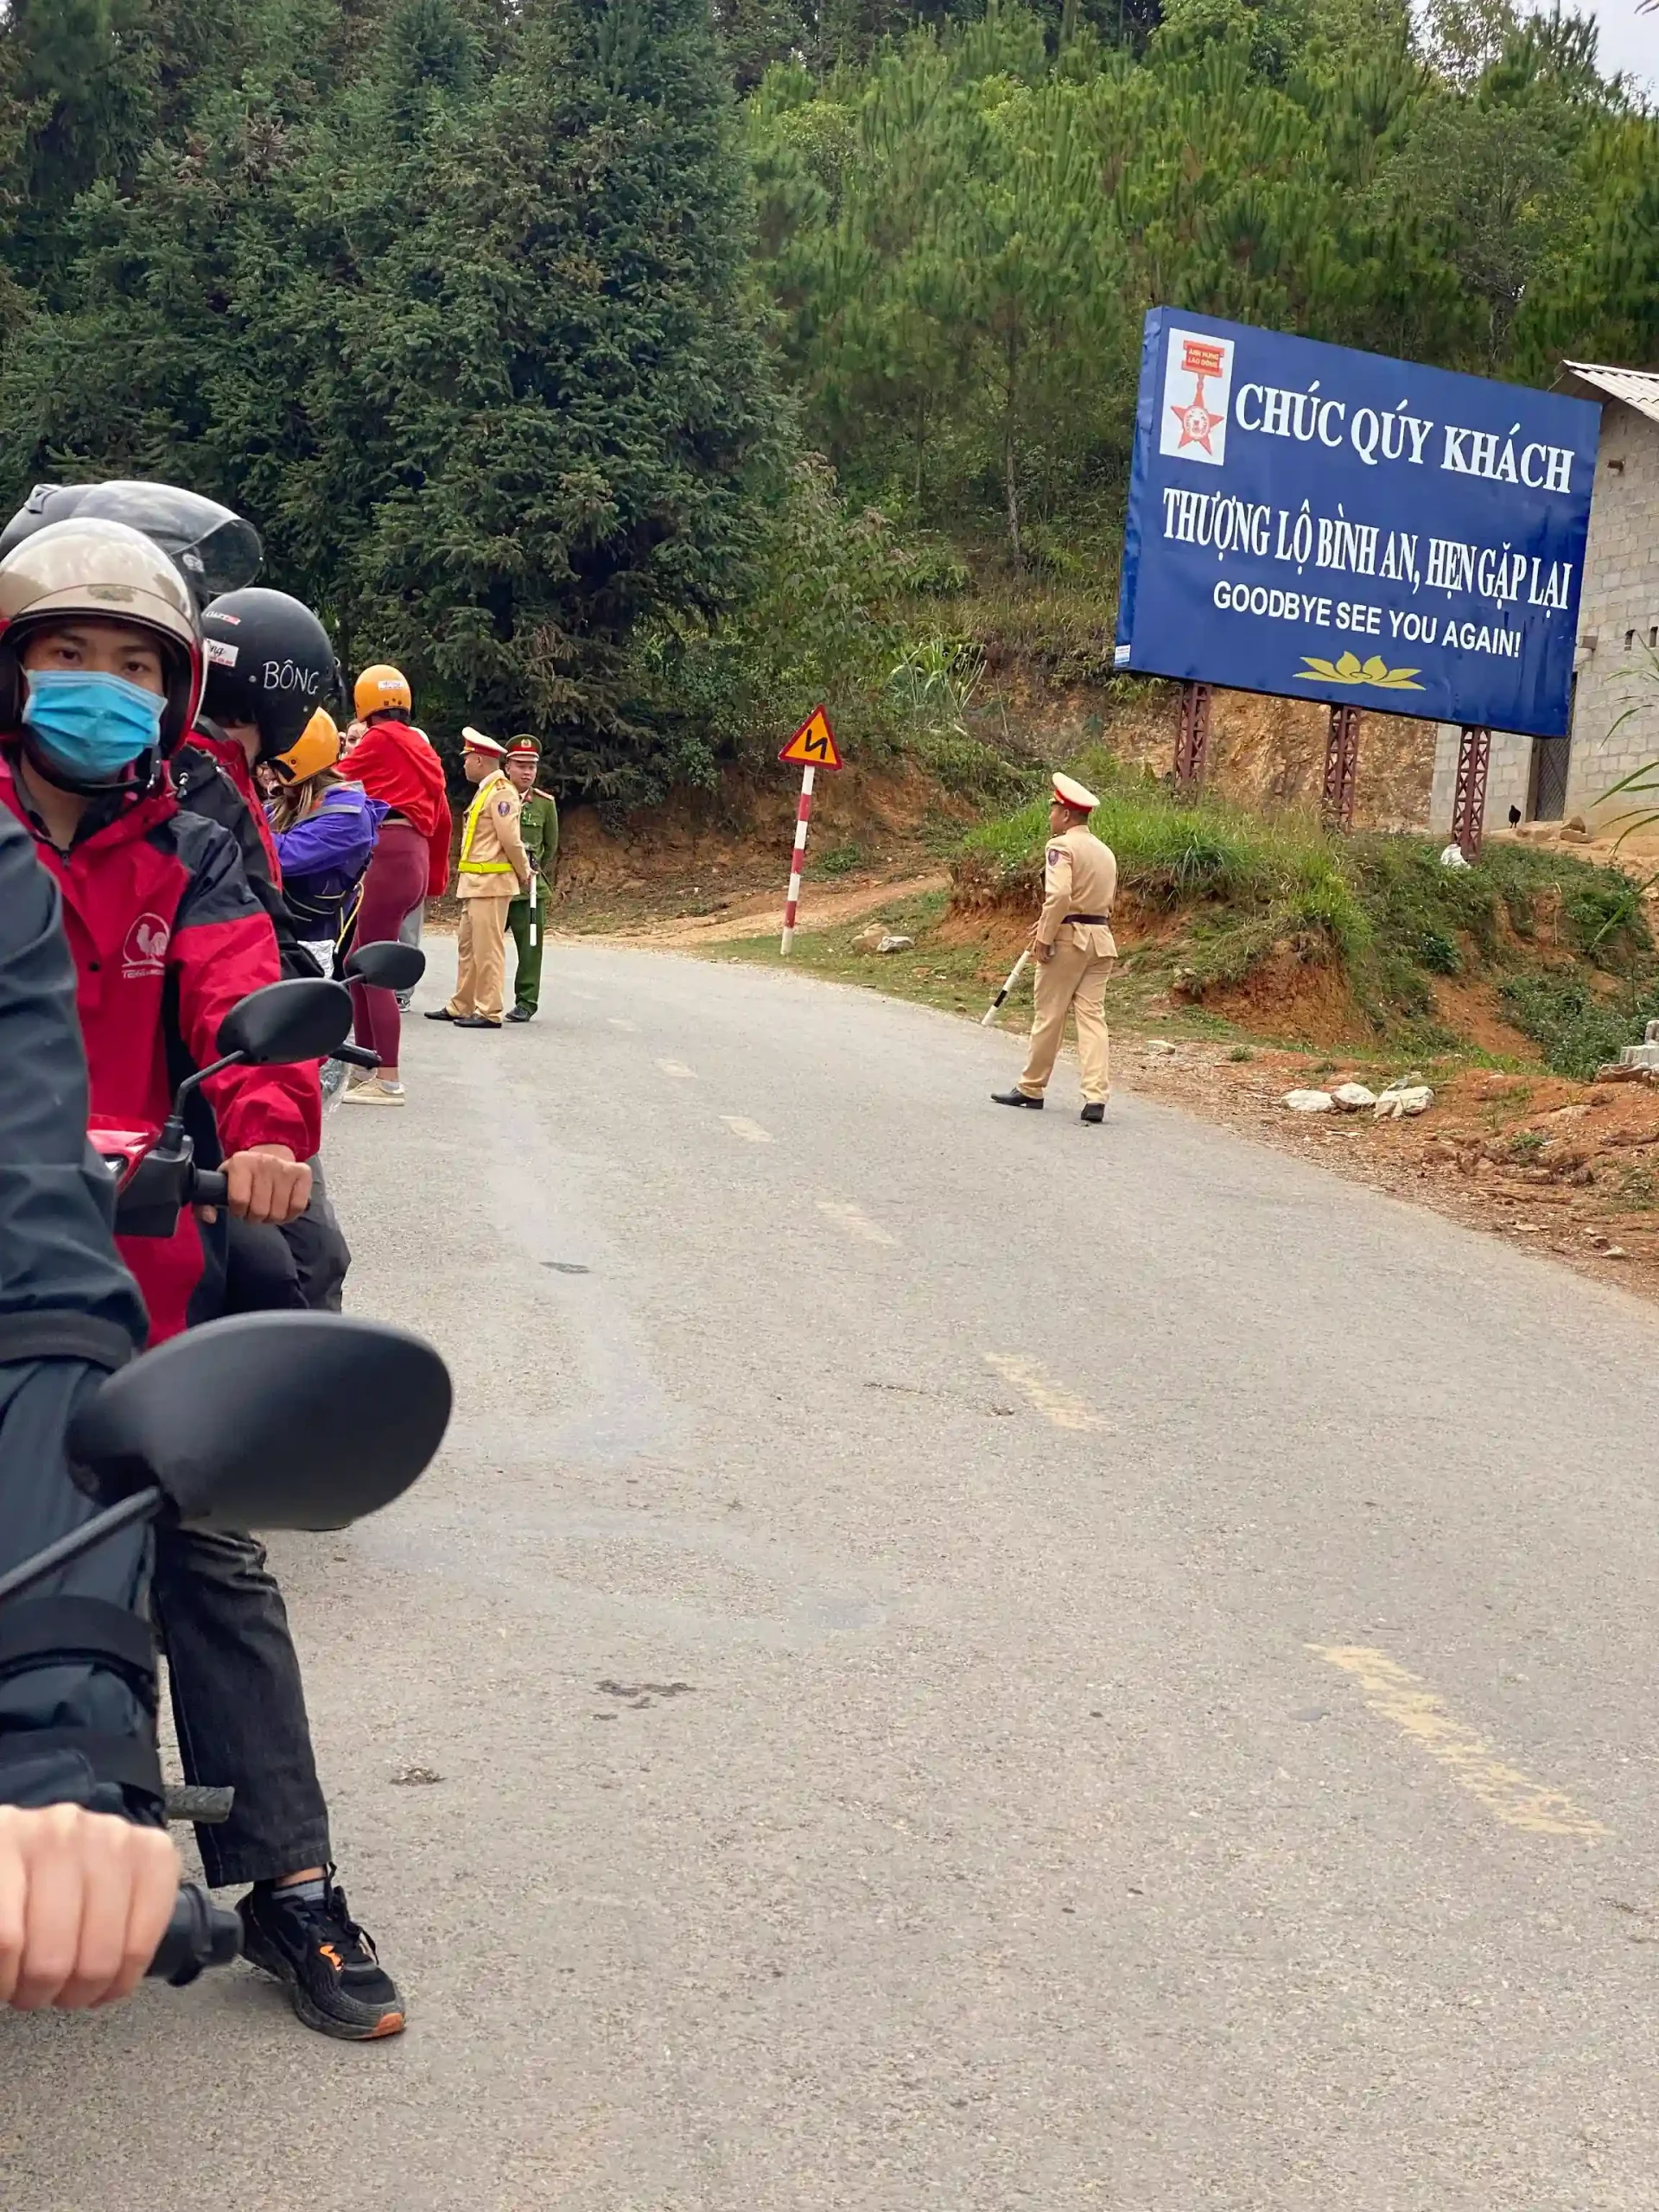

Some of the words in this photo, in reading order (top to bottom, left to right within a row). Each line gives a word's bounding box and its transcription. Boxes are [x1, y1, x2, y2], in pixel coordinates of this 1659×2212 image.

[1236, 380, 1345, 447] CHÚC
[1351, 399, 1433, 465] QÚY
[1440, 423, 1575, 493] KHÁCH
[1163, 486, 1270, 562] THƯỢNG
[1274, 499, 1313, 575] LỘ
[1316, 503, 1380, 575] BÌNH
[1379, 531, 1421, 594] AN,
[1426, 537, 1478, 600] HẸN
[1478, 541, 1527, 610] GẶP
[1528, 556, 1573, 619] LẠI
[1213, 581, 1332, 626] GOODBYE
[1336, 601, 1382, 635] SEE
[1389, 610, 1437, 644] YOU
[1441, 620, 1522, 658] AGAIN!
[263, 659, 320, 696] BÔNG
